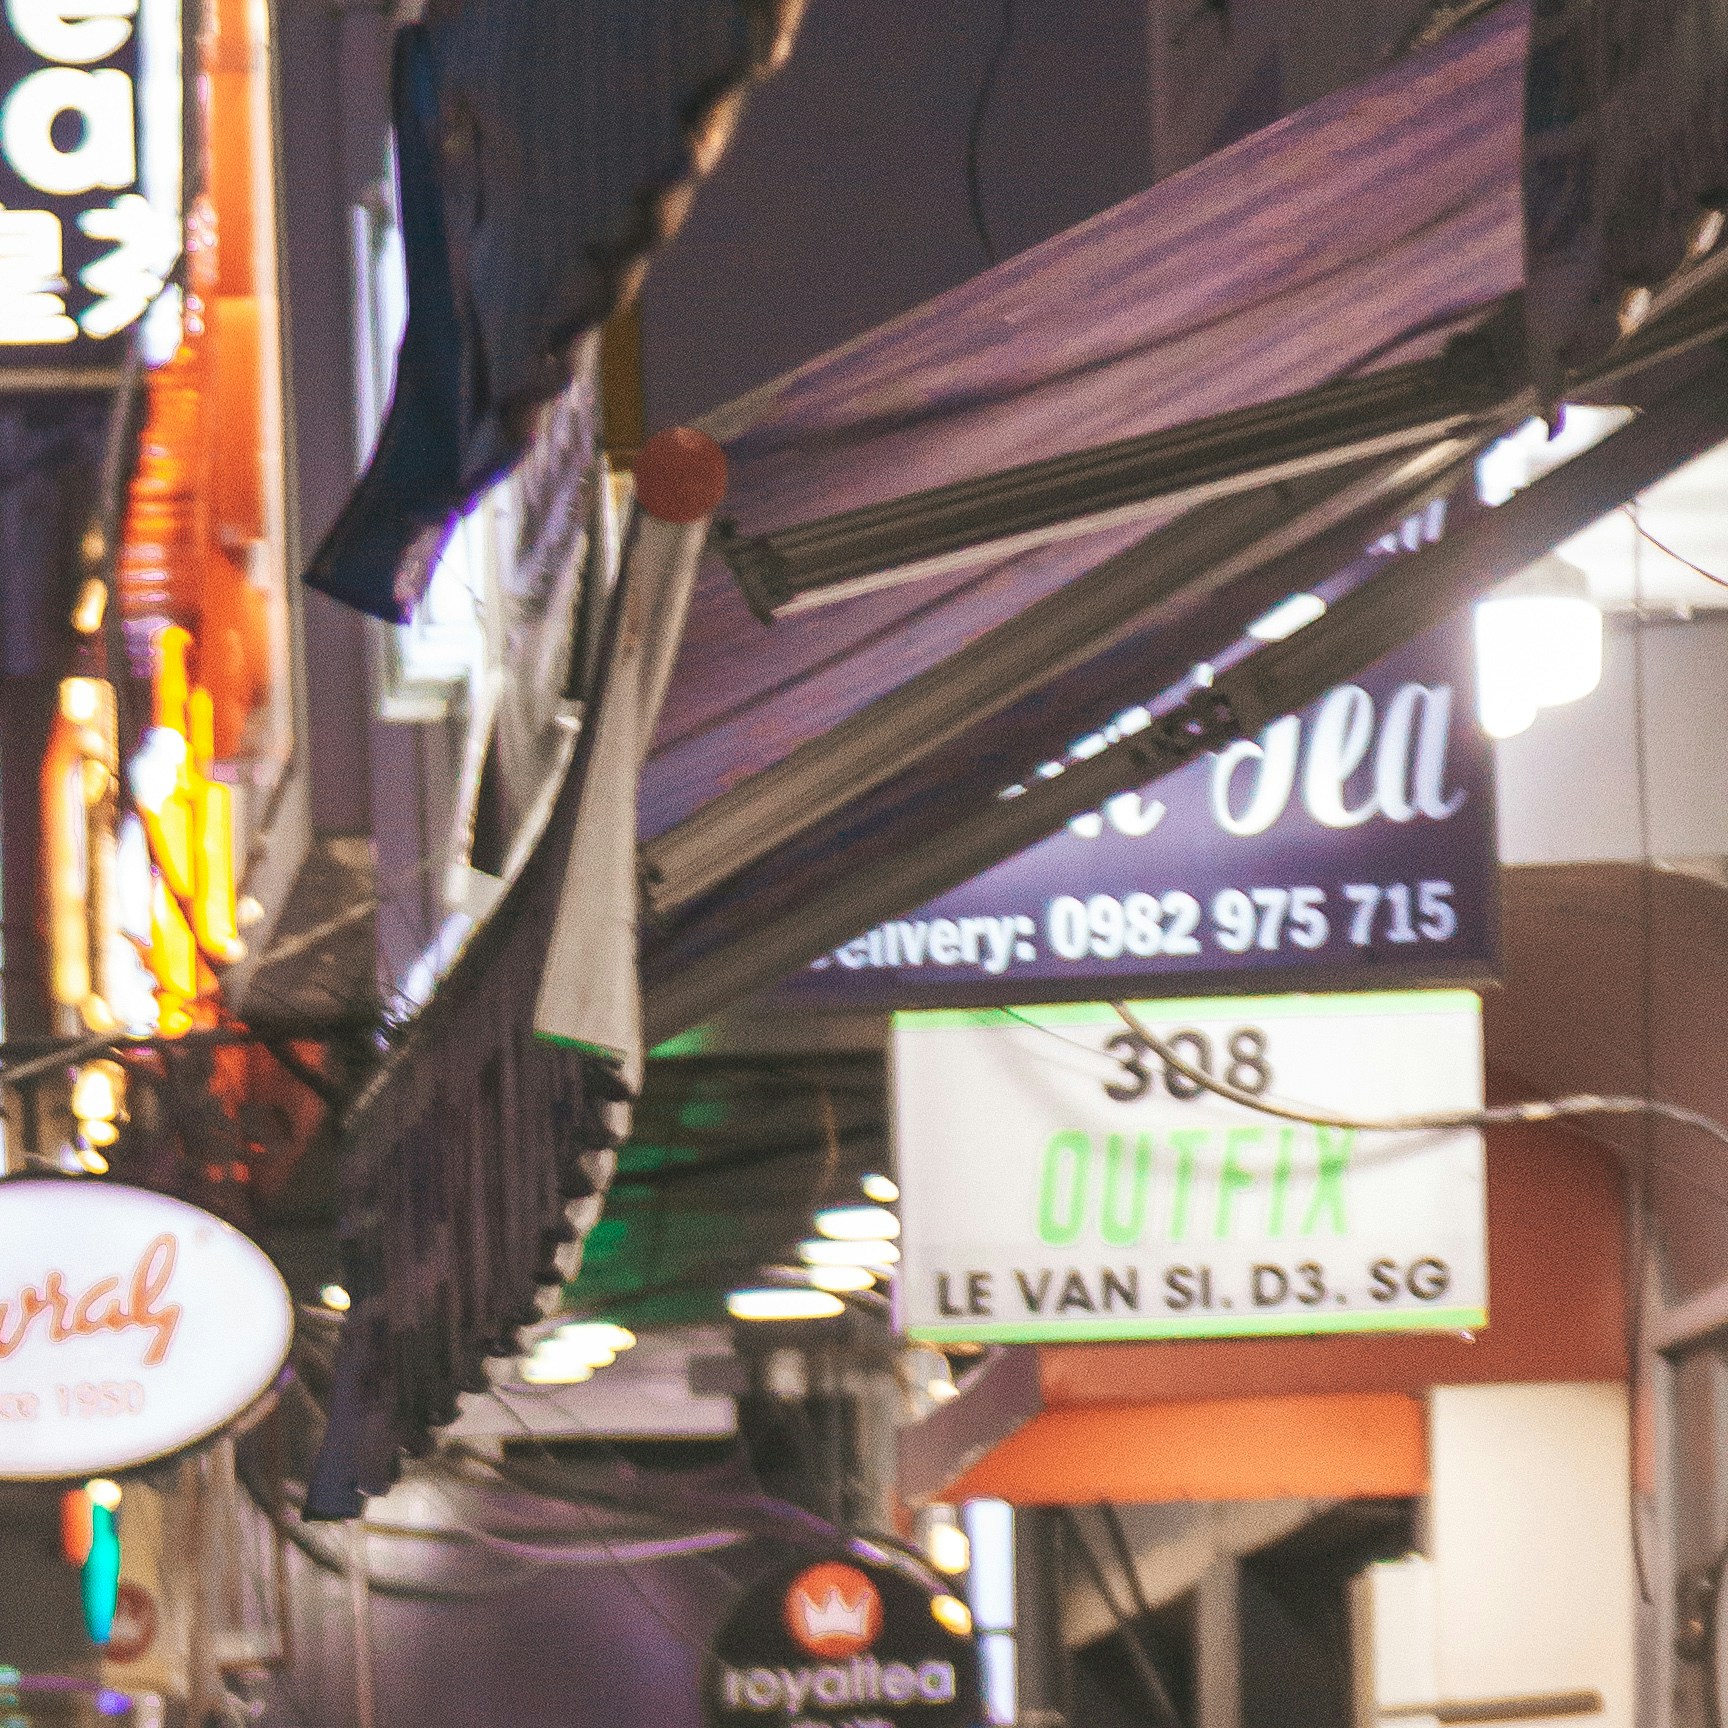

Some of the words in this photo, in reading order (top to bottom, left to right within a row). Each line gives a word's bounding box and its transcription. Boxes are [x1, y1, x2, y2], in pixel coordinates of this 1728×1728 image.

[1047, 889, 1203, 960] 0982
[1212, 883, 1330, 956] 975
[1342, 878, 1459, 949] 715
[1102, 1026, 1272, 1103] 308
[1035, 1124, 1359, 1248] OUTFIX
[936, 1270, 994, 1317] LE
[1014, 1266, 1140, 1313] VAN
[1251, 1260, 1349, 1307] D3.
[1368, 1256, 1451, 1302] SG
